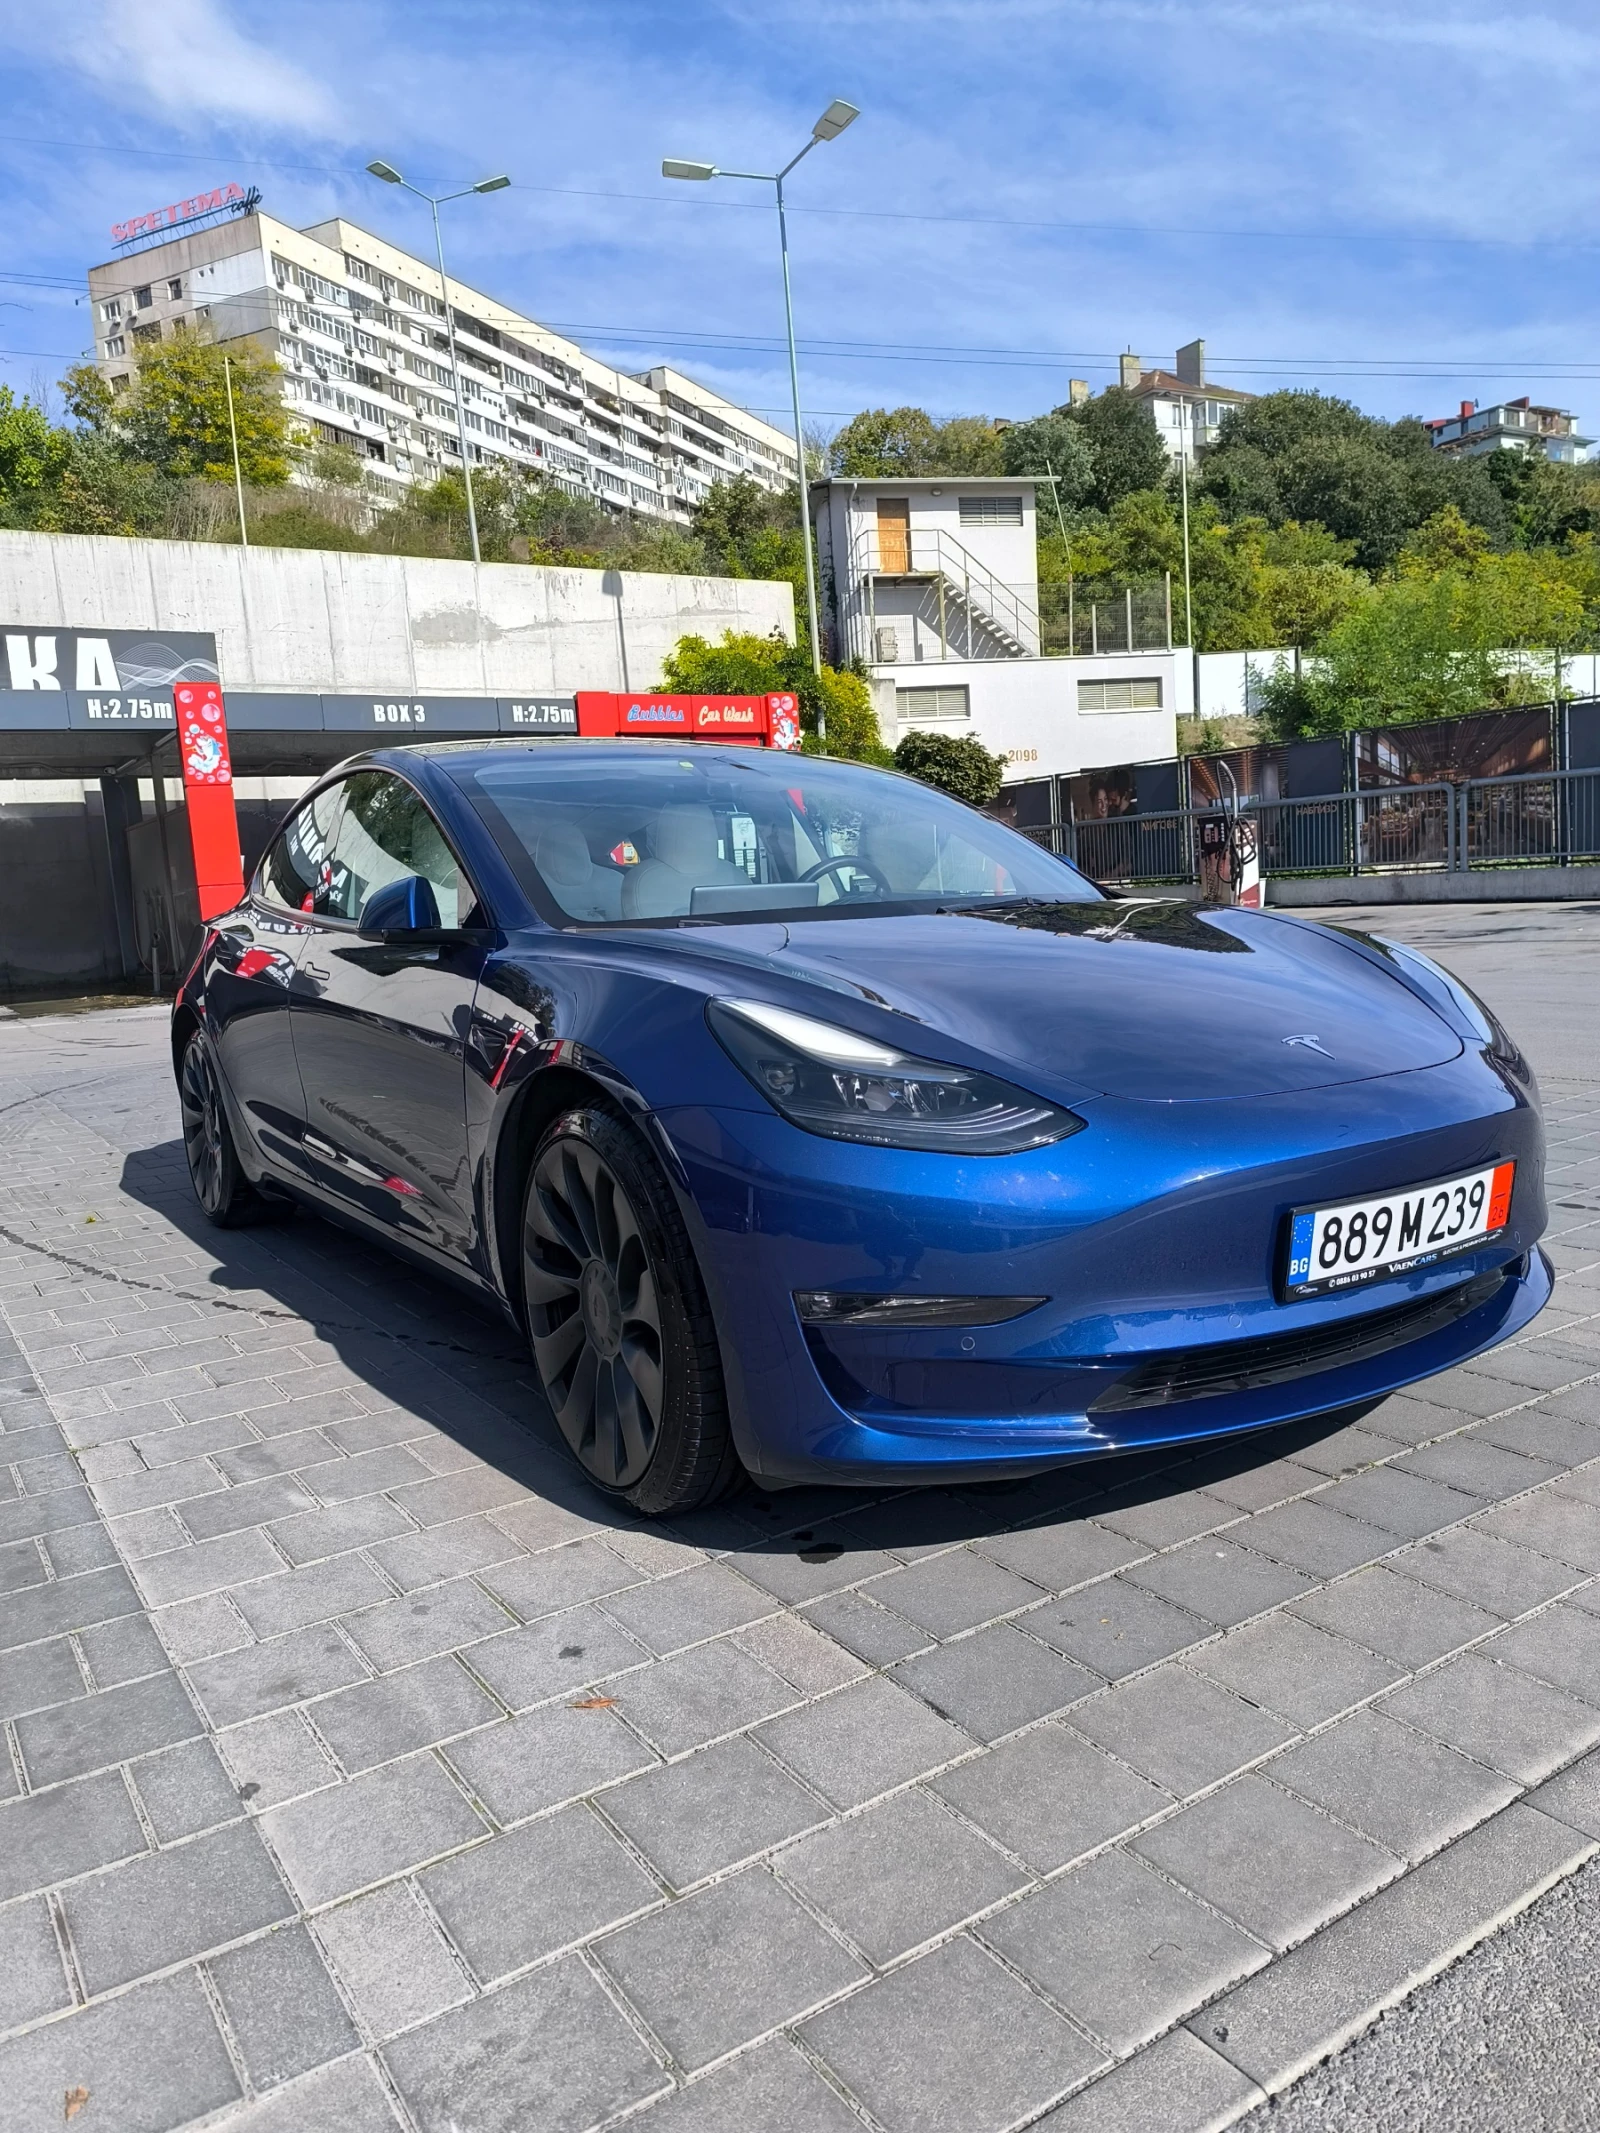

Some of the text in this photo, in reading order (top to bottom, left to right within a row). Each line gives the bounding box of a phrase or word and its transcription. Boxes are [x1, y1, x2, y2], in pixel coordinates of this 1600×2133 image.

[111, 182, 245, 242] SPETEMA
[87, 698, 173, 719] H:2.75m
[373, 704, 426, 723] BOX 3
[512, 705, 575, 723] H:2.75m
[627, 704, 754, 726] Bubbles Car Wash
[1008, 748, 1038, 762] 2098
[1318, 1206, 1394, 1269] 889
[1426, 1179, 1486, 1243] 239
[1289, 1257, 1309, 1276] BG
